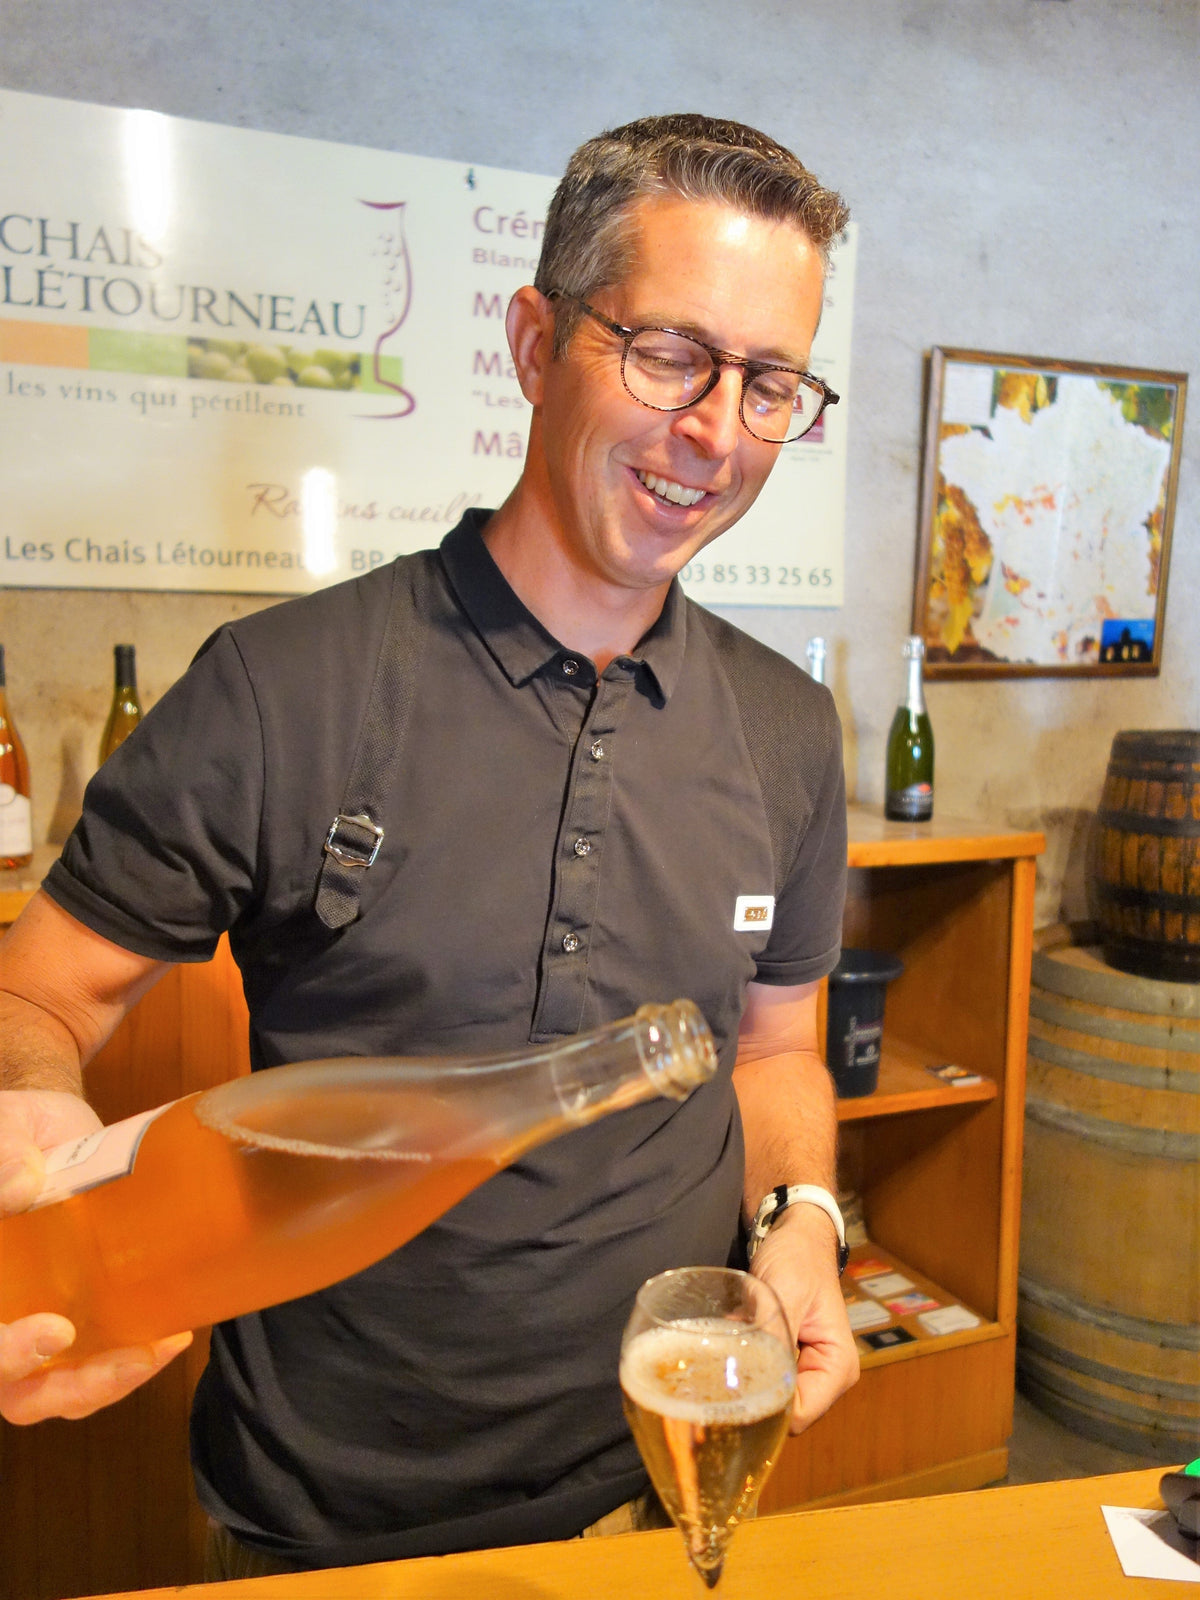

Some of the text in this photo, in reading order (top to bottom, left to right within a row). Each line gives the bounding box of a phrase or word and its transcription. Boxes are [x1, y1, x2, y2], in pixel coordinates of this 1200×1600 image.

[0, 214, 163, 269] CHAIS
[2, 264, 366, 340] LÉTOURNEAU
[8, 371, 47, 397] les
[60, 382, 118, 402] vins
[130, 389, 177, 415] qui
[246, 483, 380, 521] Rains
[5, 536, 54, 562] Les
[65, 538, 146, 565] Chais
[351, 549, 384, 571] BP
[679, 563, 833, 587] 03 85 33 25 65
